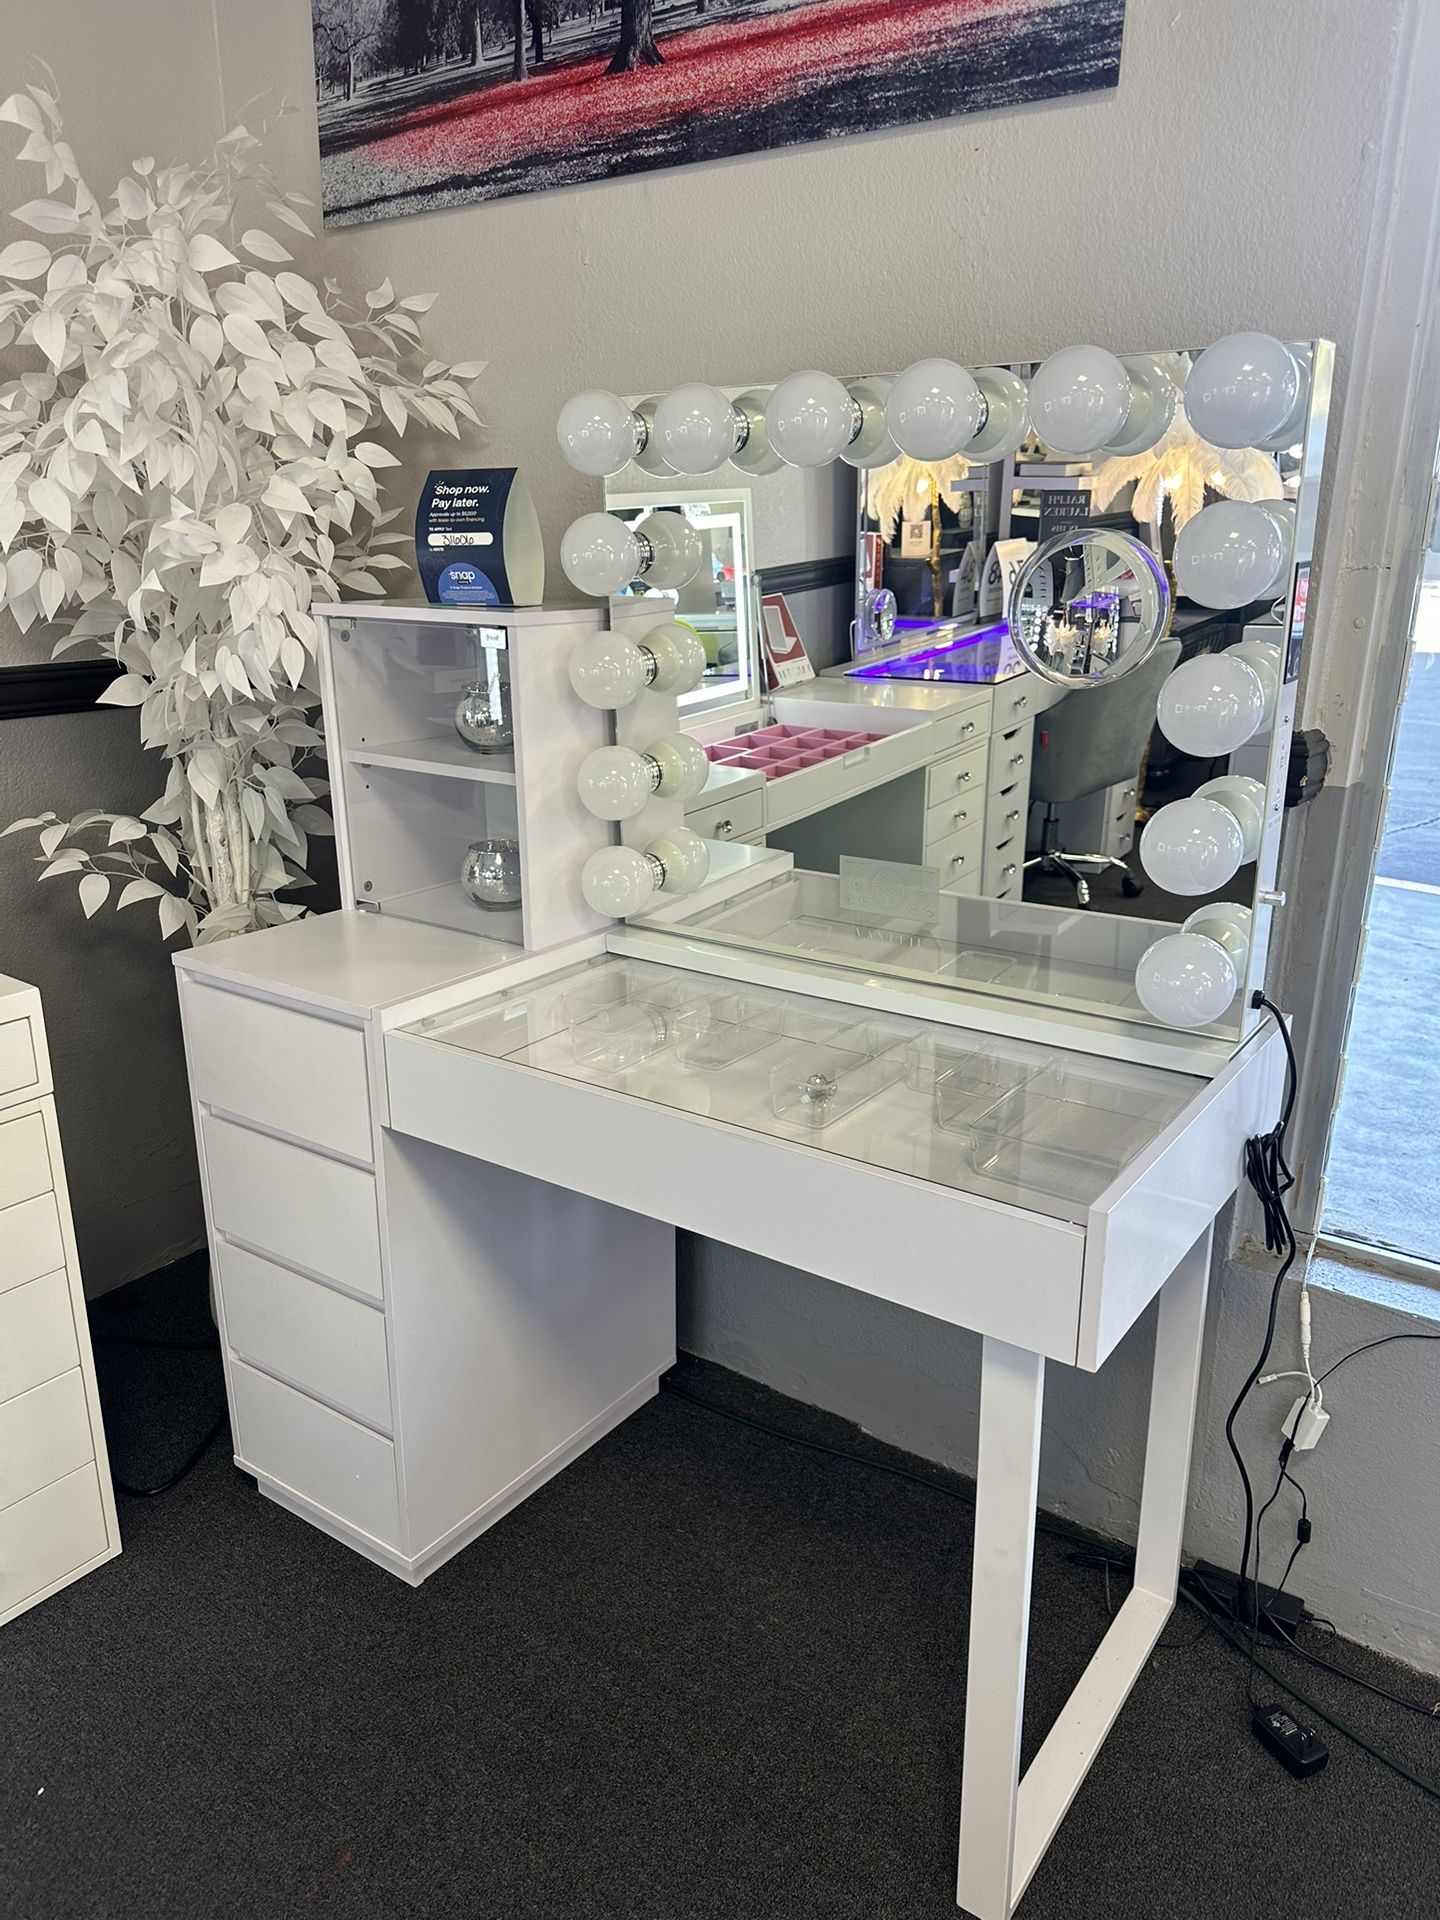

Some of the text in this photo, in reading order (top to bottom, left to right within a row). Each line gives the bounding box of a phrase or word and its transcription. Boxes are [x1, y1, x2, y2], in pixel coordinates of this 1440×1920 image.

[435, 485, 490, 496] Shop now.
[431, 498, 479, 510] Pay later.
[449, 570, 476, 583] snap
